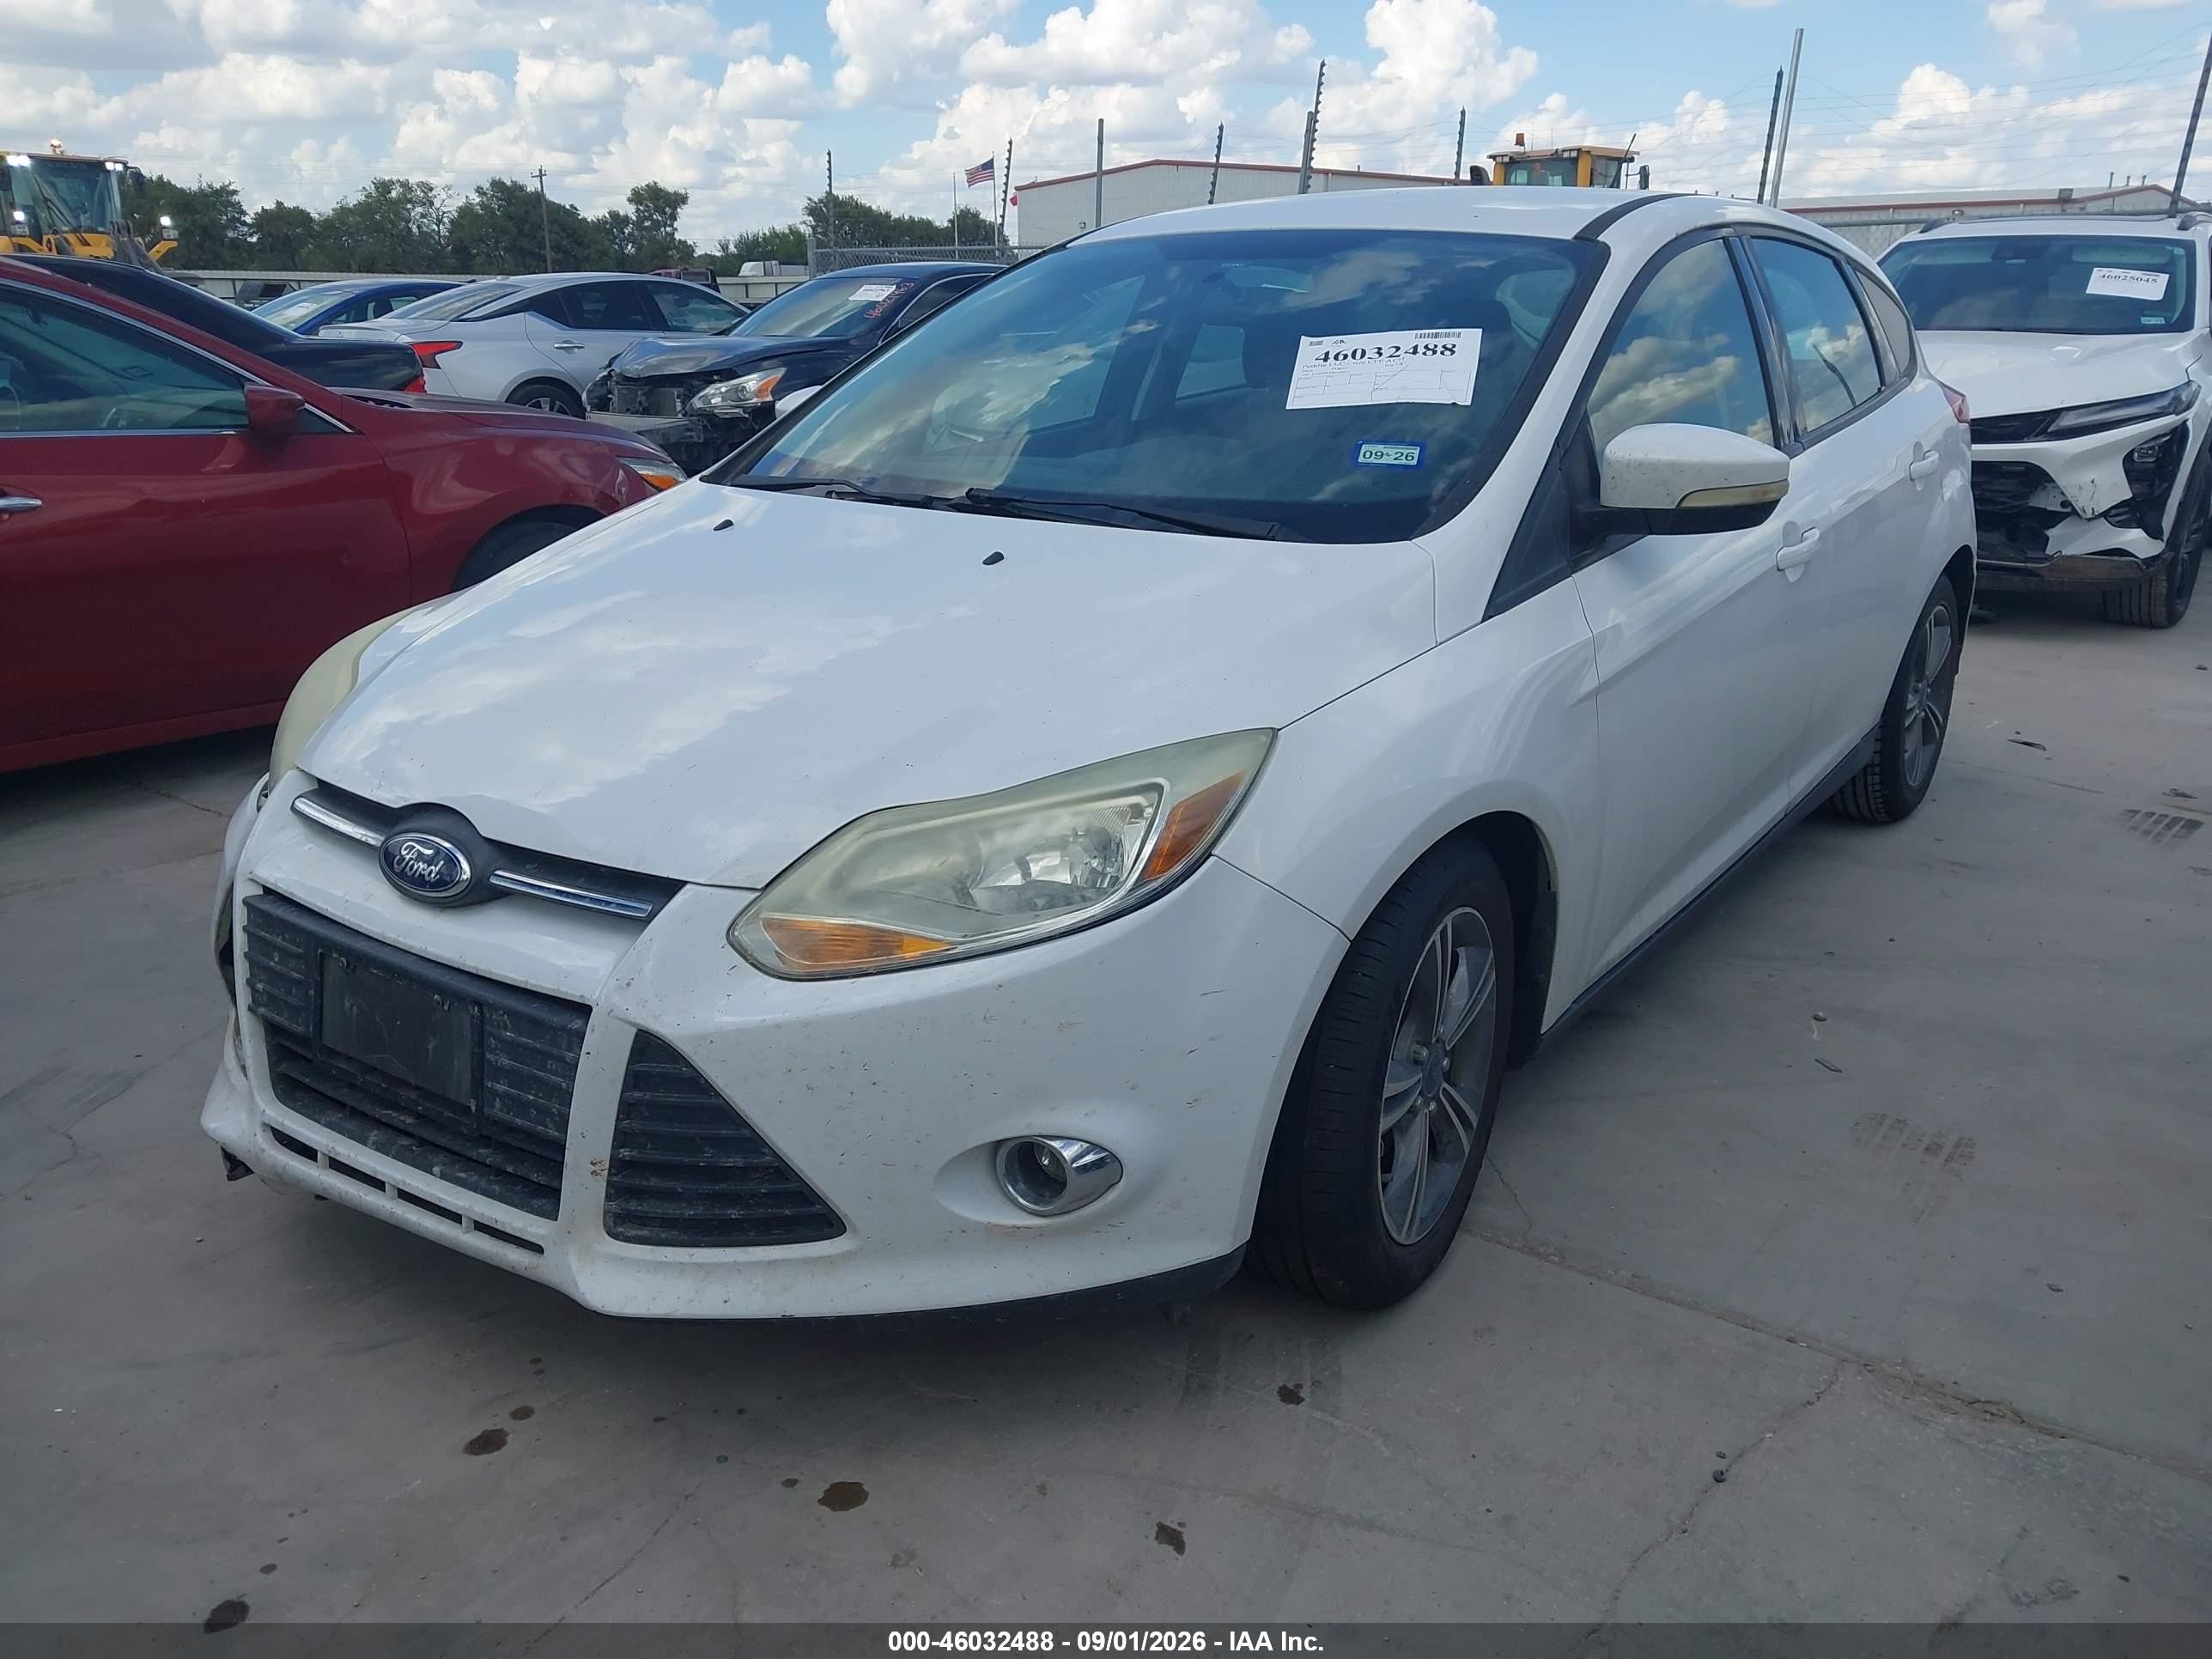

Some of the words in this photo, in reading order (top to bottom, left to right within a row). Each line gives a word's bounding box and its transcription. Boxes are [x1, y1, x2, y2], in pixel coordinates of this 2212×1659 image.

[1315, 343, 1457, 362] 46032488
[1362, 450, 1384, 459] 09
[1393, 451, 1416, 461] 26
[393, 842, 445, 883] Ford
